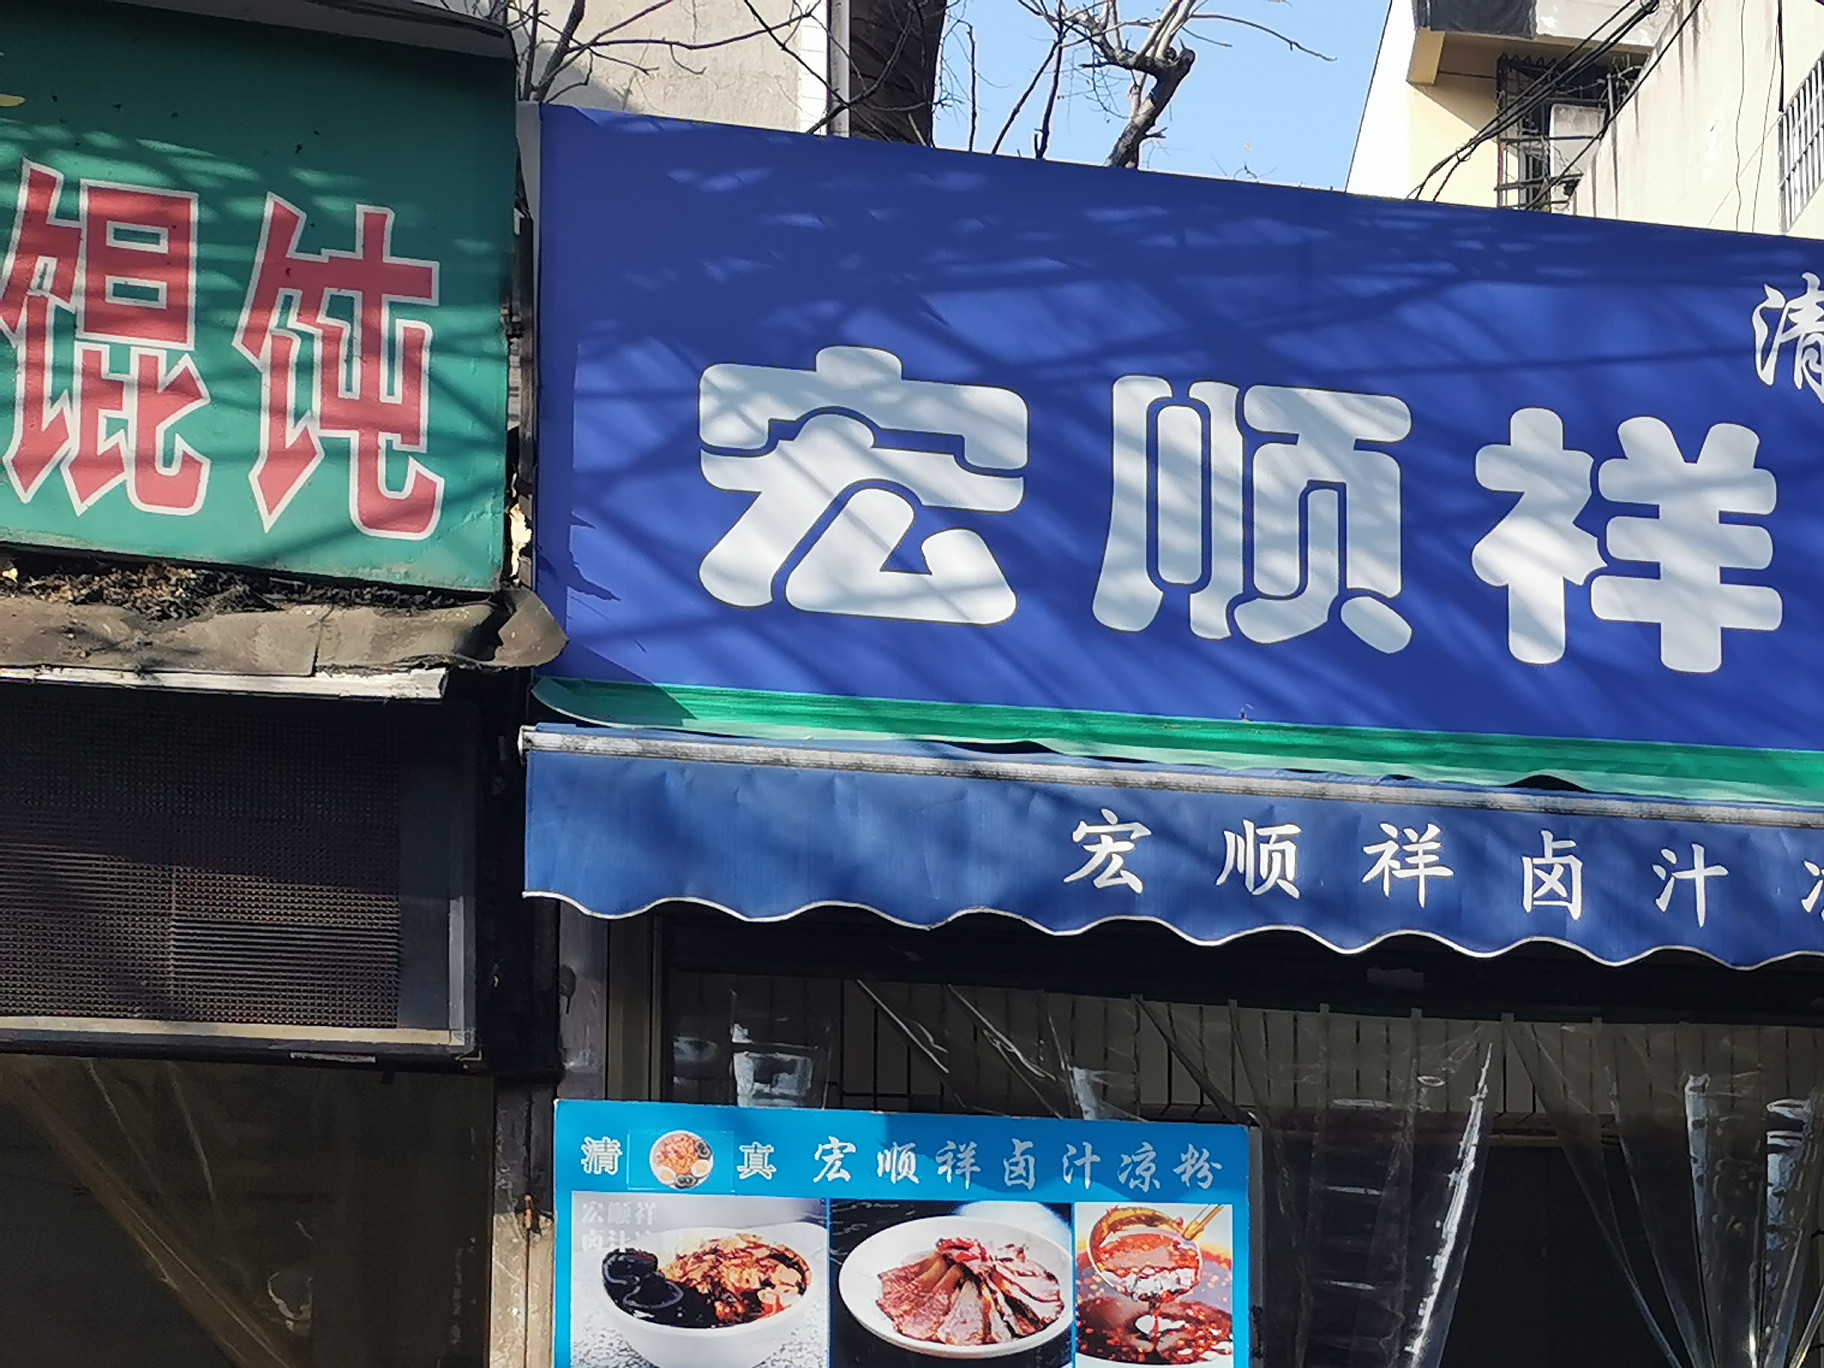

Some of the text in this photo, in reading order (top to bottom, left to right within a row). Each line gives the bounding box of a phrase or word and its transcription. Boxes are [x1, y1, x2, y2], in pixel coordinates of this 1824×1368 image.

[0, 158, 446, 541] 馄饨
[581, 1135, 1224, 1190] 清真 宏顺祥卤汁凉粉
